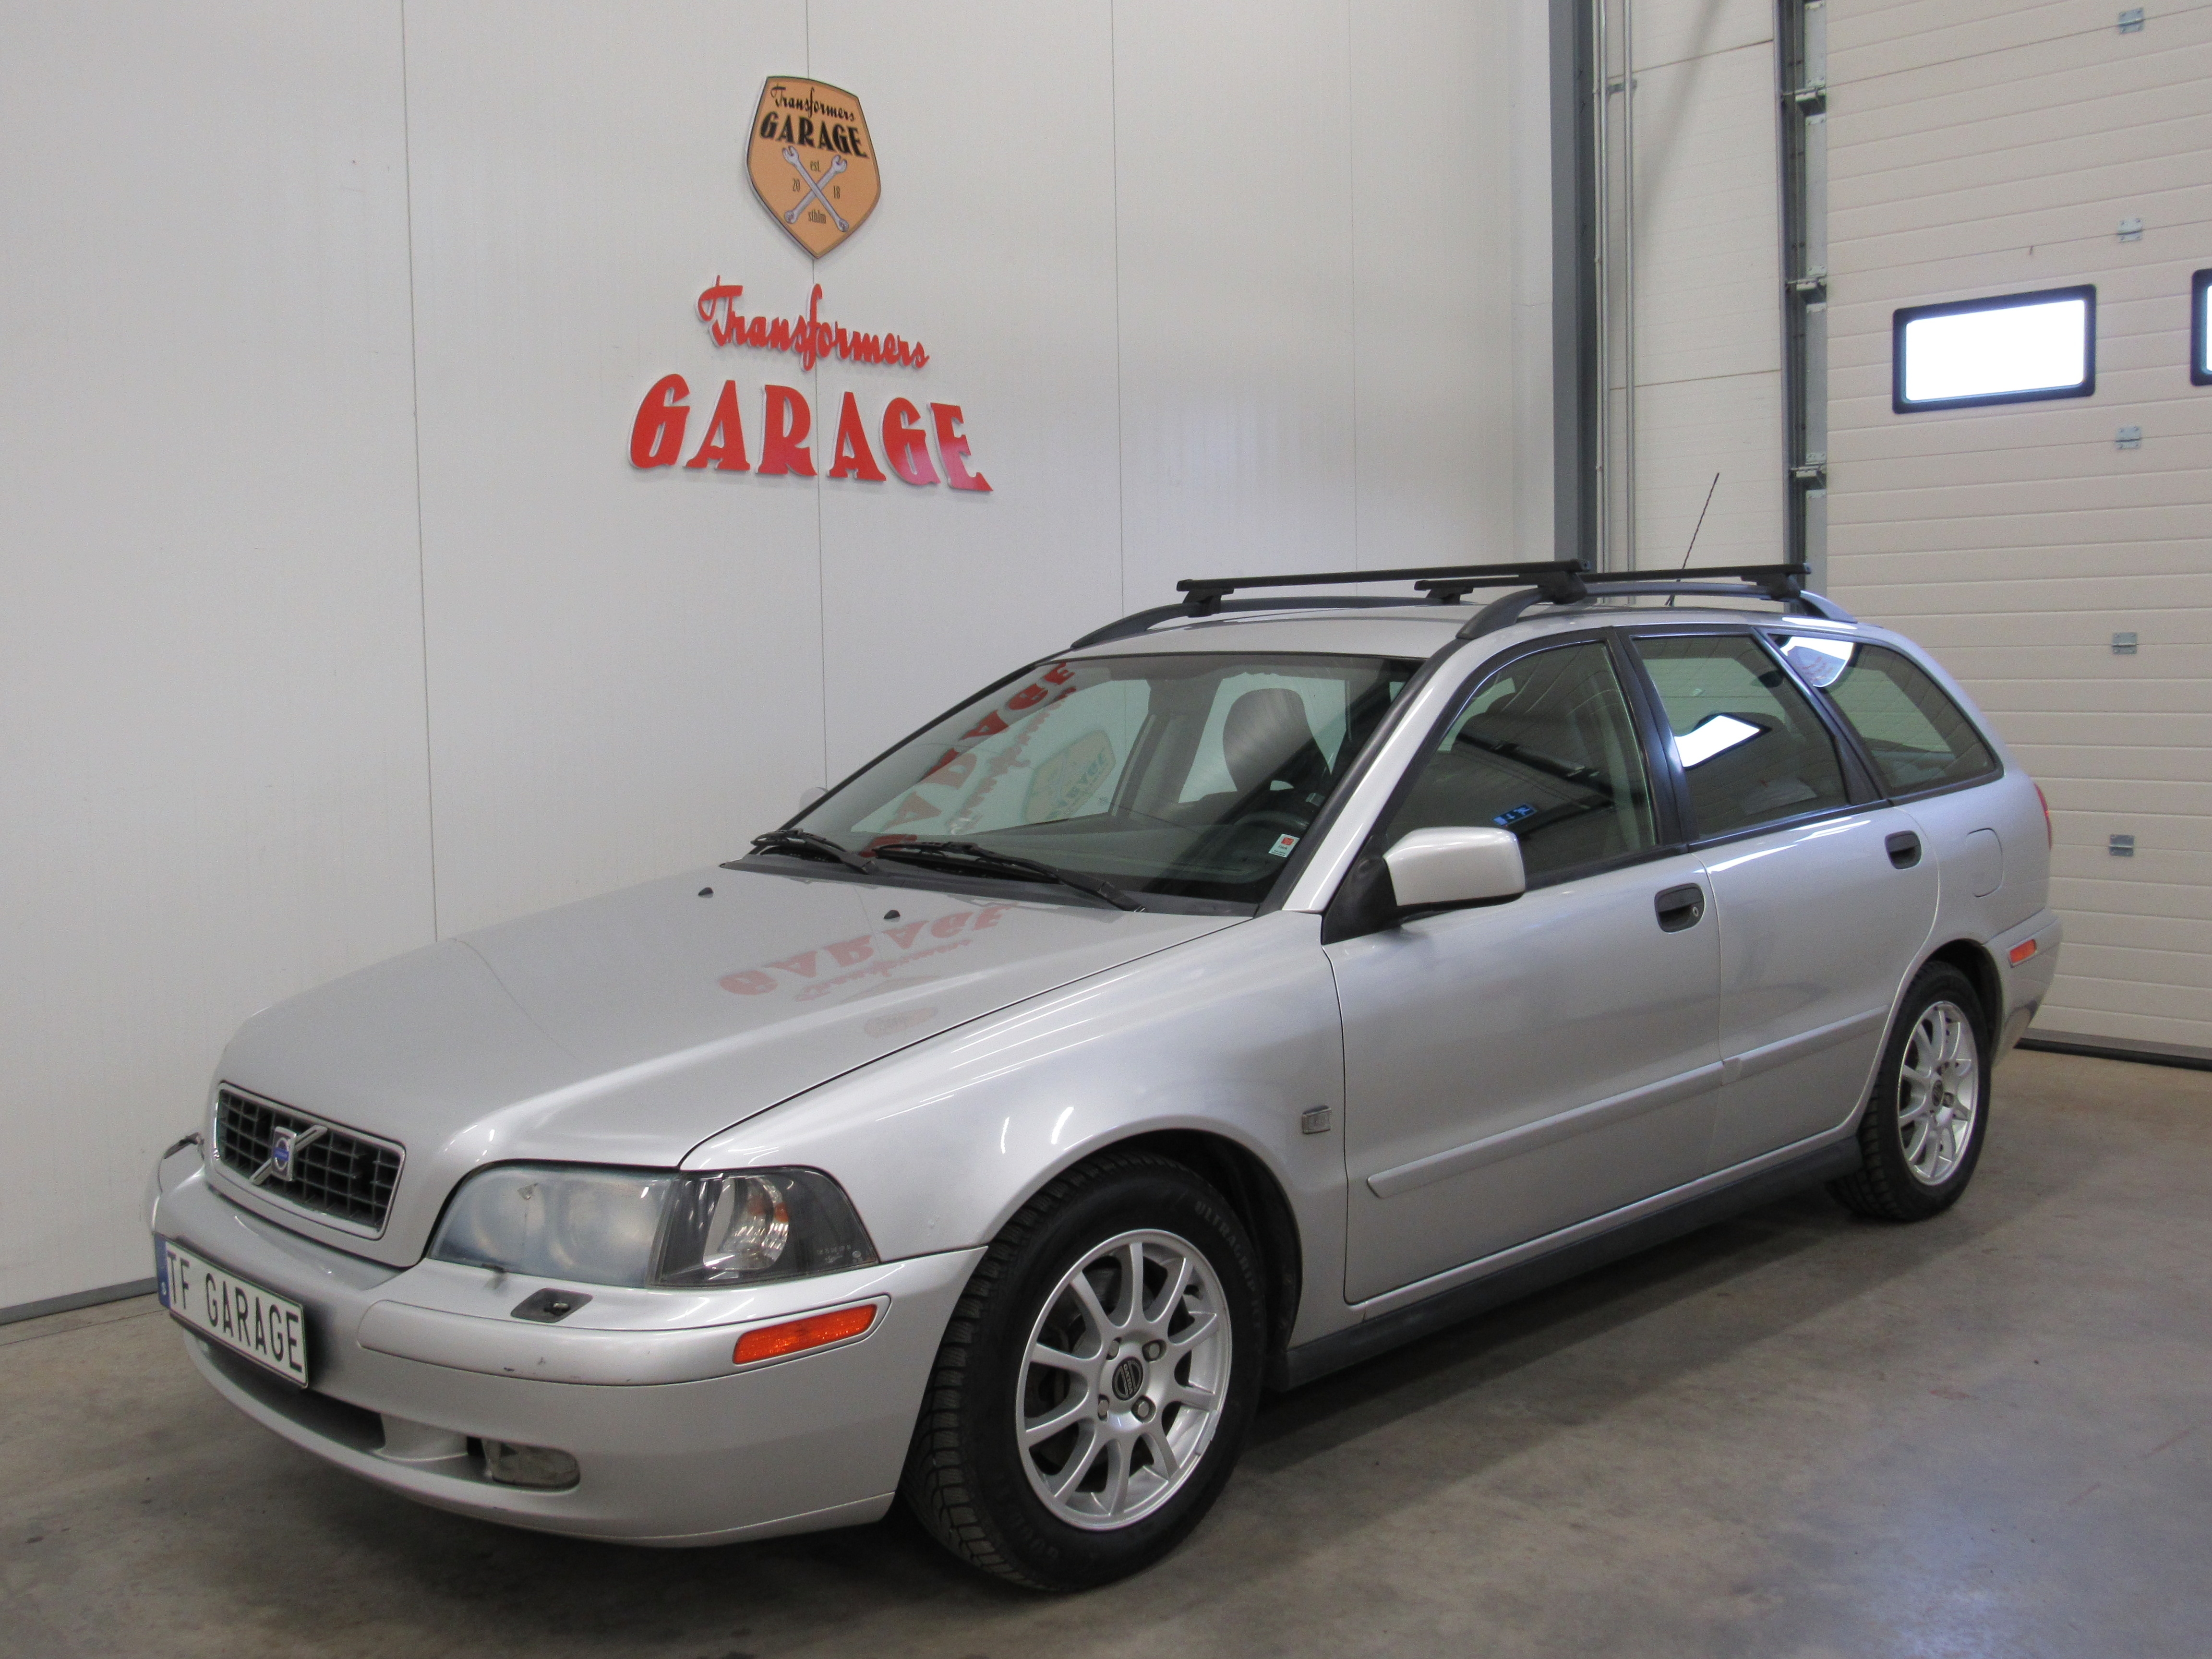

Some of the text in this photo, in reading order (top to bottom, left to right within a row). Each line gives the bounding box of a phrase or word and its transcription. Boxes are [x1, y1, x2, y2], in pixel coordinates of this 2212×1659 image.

[770, 83, 855, 121] Transformers
[760, 111, 869, 158] GARAGE
[793, 178, 841, 199] 20 18
[696, 275, 929, 371] Transformers
[628, 373, 993, 492] GARAGE
[168, 1250, 190, 1310] TF
[206, 1273, 302, 1373] GARAGE
[1123, 1363, 1133, 1395] VOLVO
